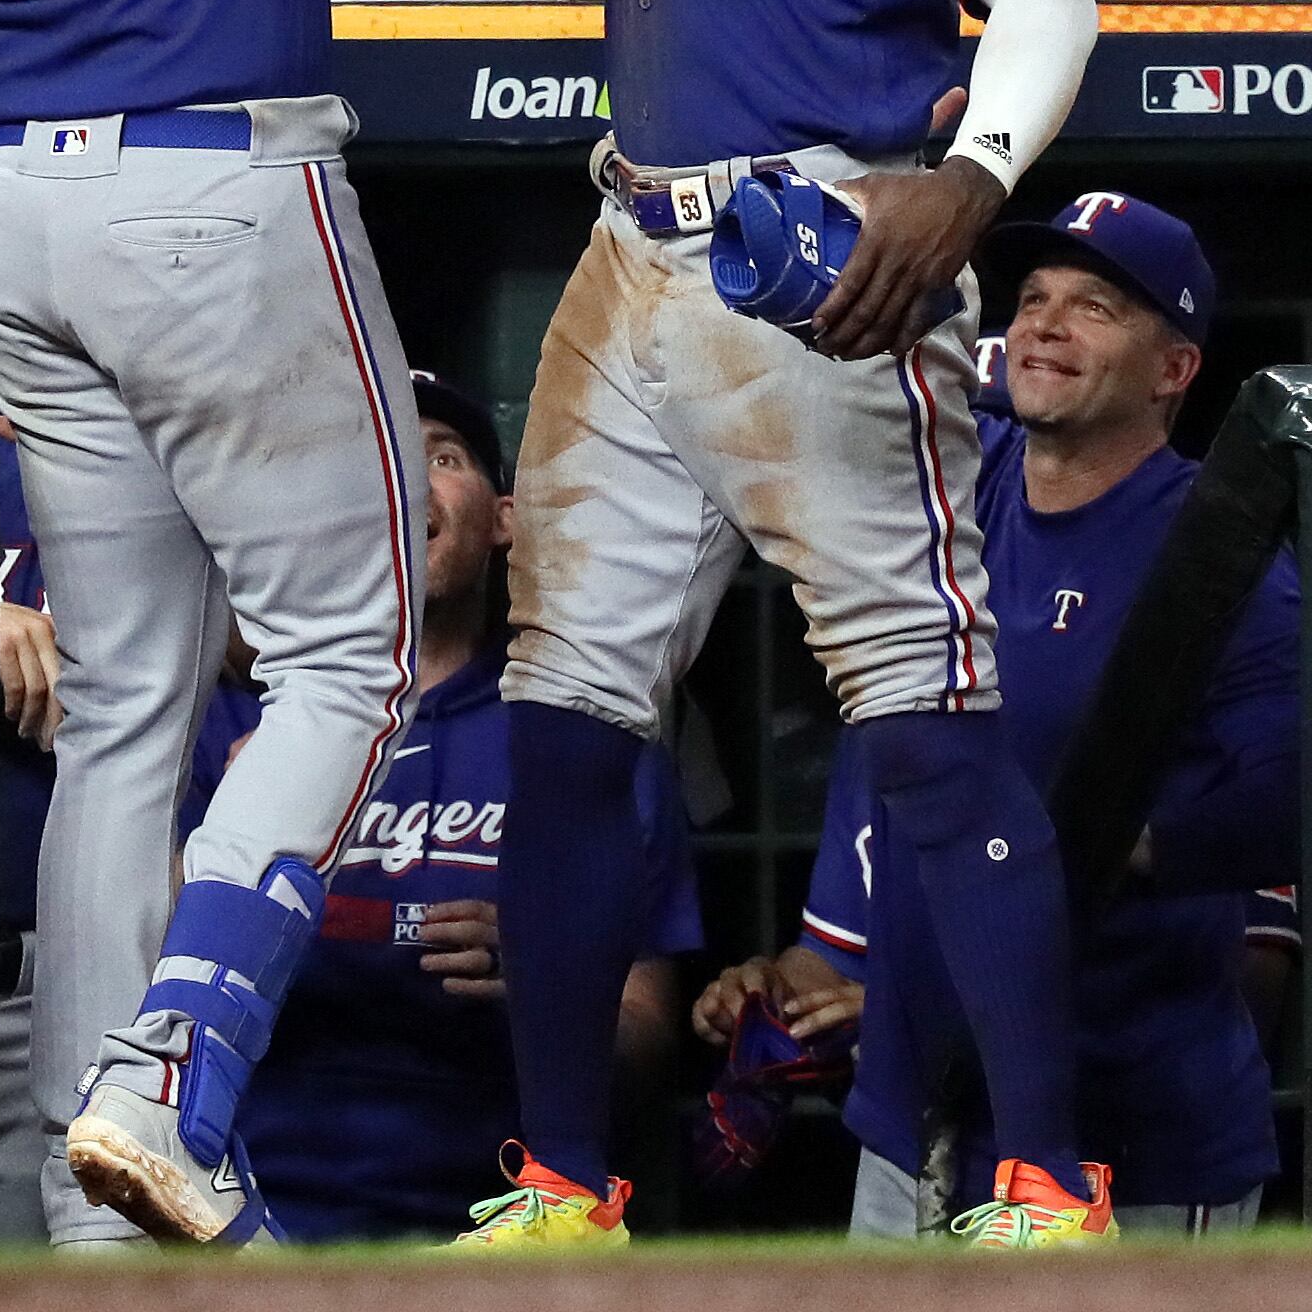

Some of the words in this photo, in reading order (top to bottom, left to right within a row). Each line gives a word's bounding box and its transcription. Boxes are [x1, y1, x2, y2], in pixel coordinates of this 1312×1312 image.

[470, 67, 611, 121] loan
[972, 135, 1014, 166] adidas
[679, 190, 703, 222] 53
[1066, 191, 1128, 236] T
[796, 222, 820, 267] 53
[974, 336, 1007, 386] T
[1052, 588, 1087, 631] T
